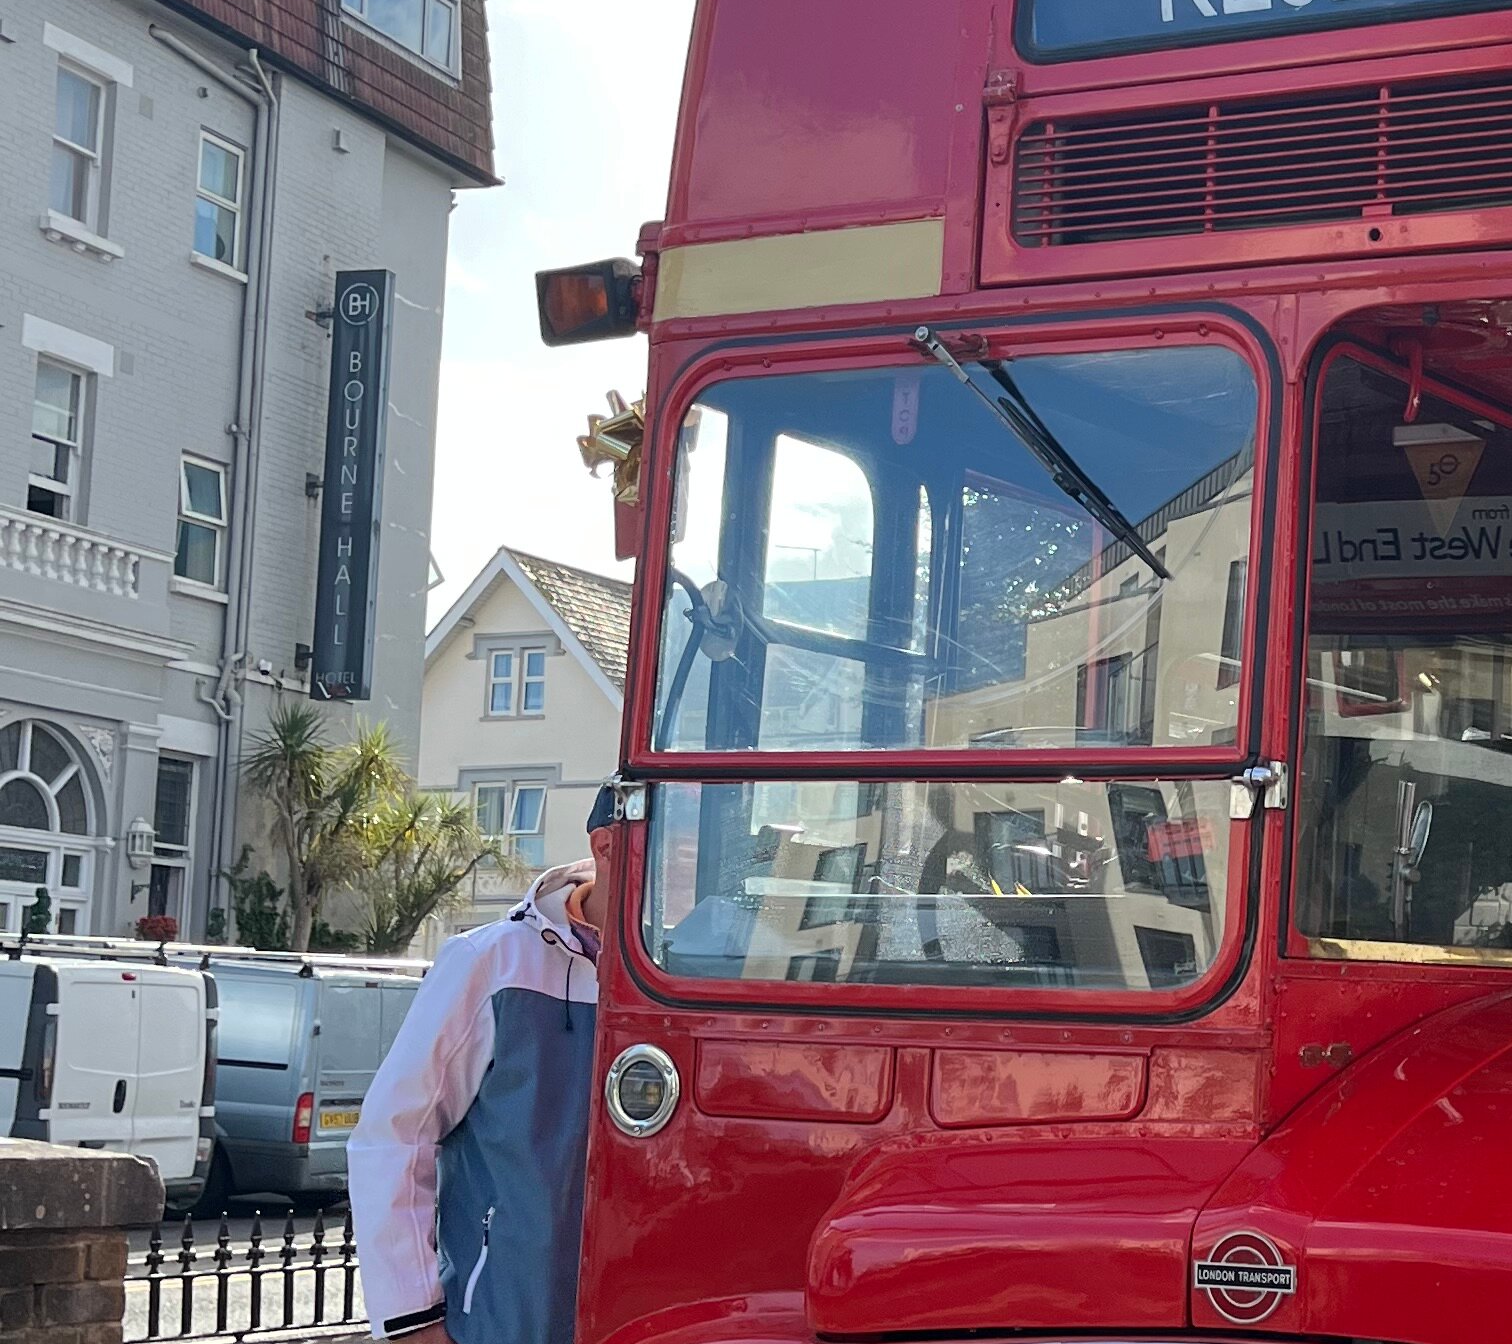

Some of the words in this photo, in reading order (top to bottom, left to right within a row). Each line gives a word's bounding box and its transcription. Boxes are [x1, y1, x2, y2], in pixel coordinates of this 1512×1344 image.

[339, 350, 365, 515] BOURNE
[333, 536, 353, 646] HALL
[315, 671, 356, 684] HOTEL
[1198, 1269, 1235, 1282] LONDON
[1237, 1270, 1291, 1285] TRANSPORT
